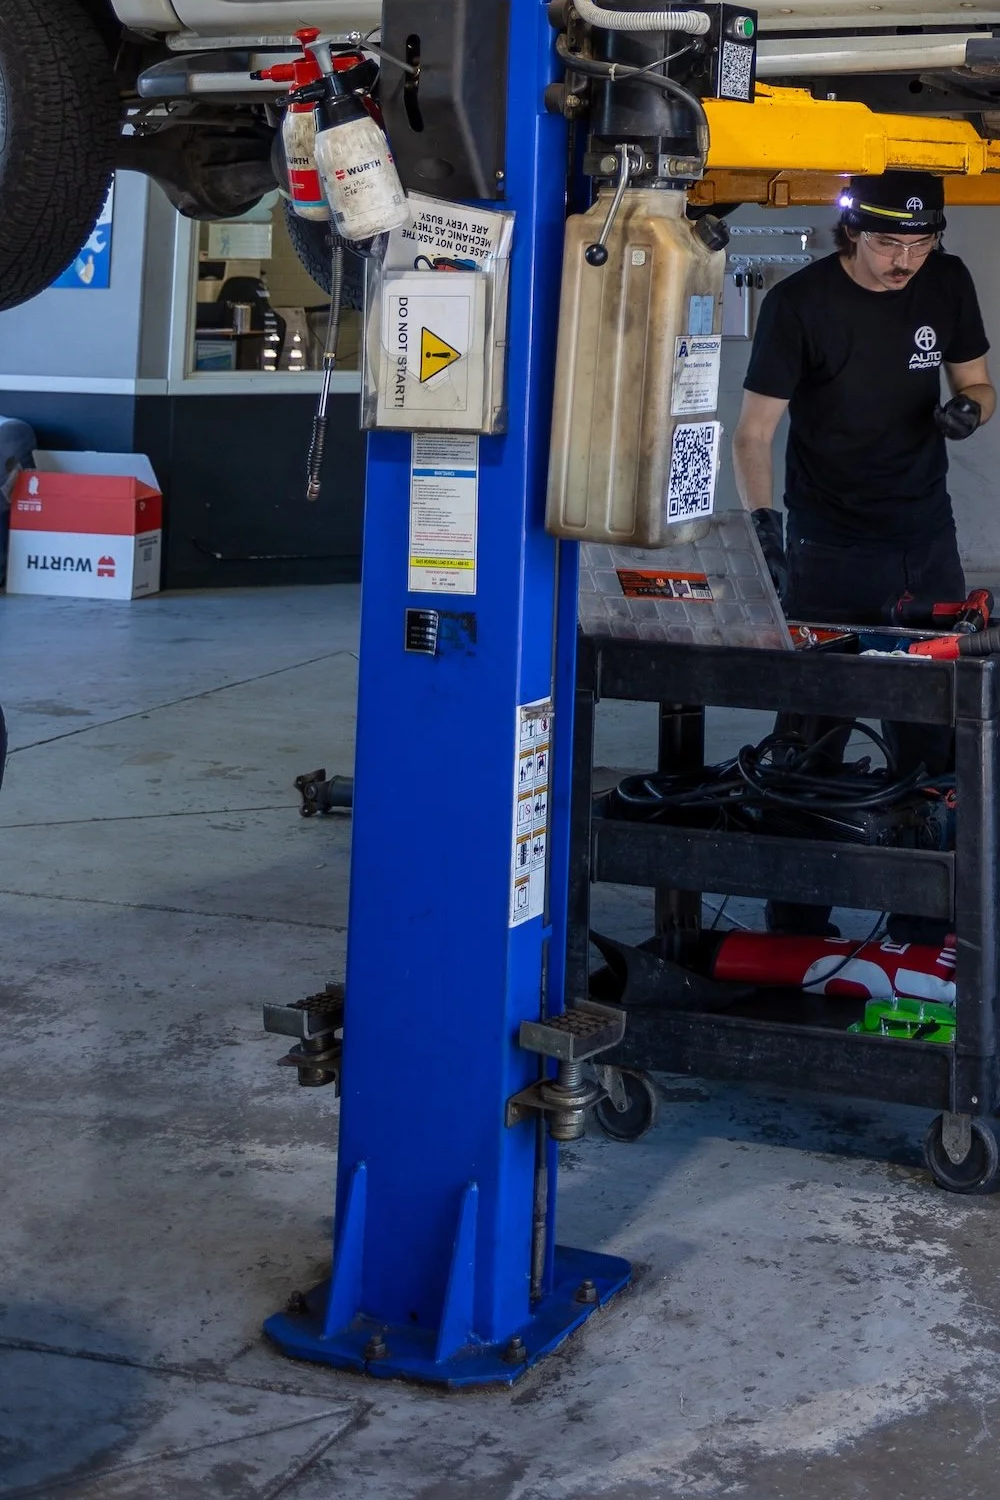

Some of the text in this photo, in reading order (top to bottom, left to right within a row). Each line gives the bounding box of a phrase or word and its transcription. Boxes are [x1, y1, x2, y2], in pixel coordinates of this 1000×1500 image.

[347, 159, 381, 176] WÜRTH
[413, 221, 432, 233] THEY
[419, 212, 489, 235] ARE VERY BUSY.
[402, 229, 415, 240] THE
[418, 234, 434, 244] ASK
[448, 230, 492, 248] MECHANIC
[436, 240, 452, 249] NOT
[455, 243, 467, 253] DO
[394, 297, 408, 408] DO NOT START!
[909, 351, 942, 364] AUTO
[27, 555, 92, 572] WÜRTH
